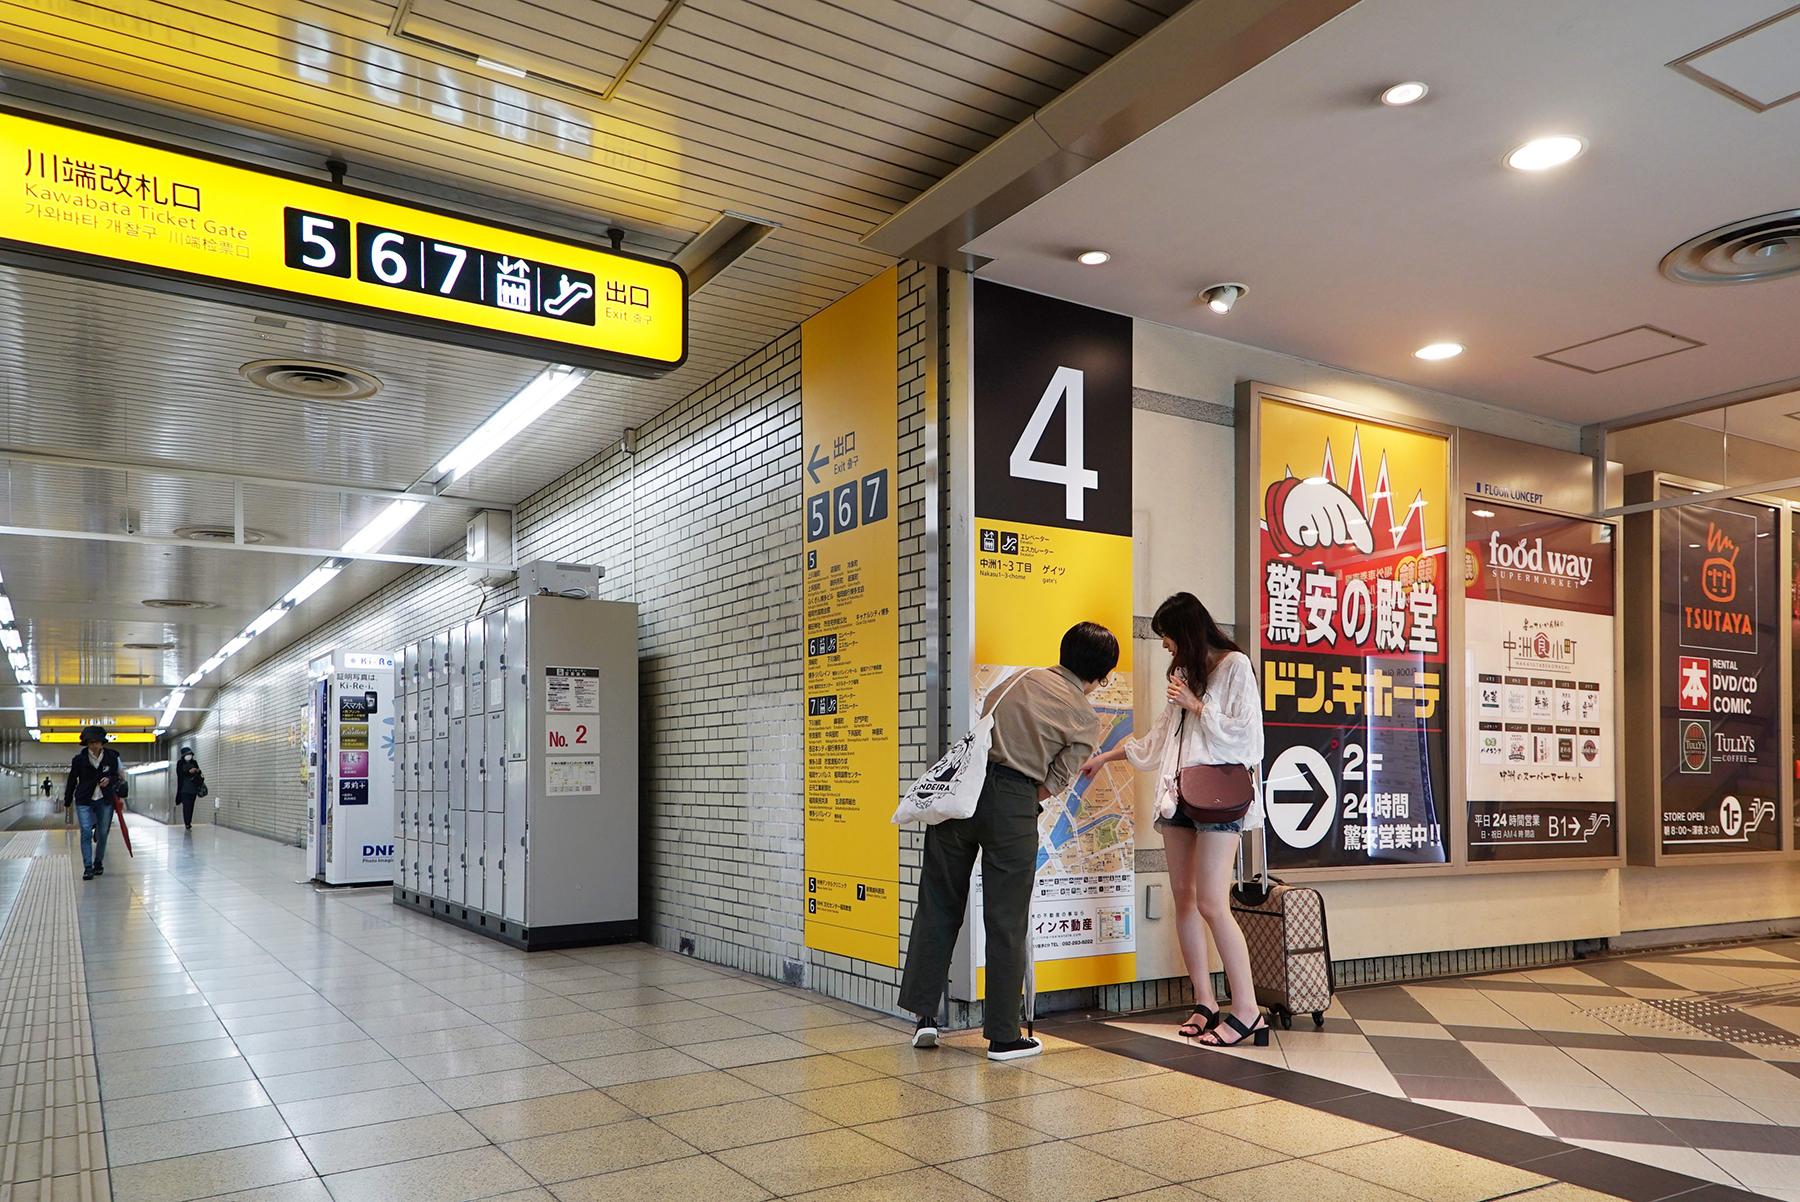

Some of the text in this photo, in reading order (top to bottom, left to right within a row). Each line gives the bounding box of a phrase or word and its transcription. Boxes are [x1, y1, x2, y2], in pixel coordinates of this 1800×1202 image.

[25, 149, 200, 212] 川端改札口
[25, 183, 248, 240] Kawabata Ticket Gate
[25, 203, 157, 239] 가와바타 개찰구
[301, 216, 467, 294] 5 6 7
[606, 280, 649, 309] 出口
[606, 307, 628, 321] Exit
[833, 431, 855, 459] 出口
[1009, 365, 1098, 521] 4
[834, 461, 846, 475] Exit
[1484, 483, 1543, 505] FLOOR CONCEPT
[812, 477, 880, 536] 5 6 7
[1020, 533, 1050, 542] エレベーター
[809, 552, 816, 568] 5
[1020, 545, 1054, 555] エスカレーター
[1489, 530, 1543, 572] food
[1547, 551, 1593, 586] way
[1042, 565, 1066, 576] ゲイツ
[1492, 569, 1579, 589] SUPERMARKET
[1265, 560, 1439, 653] 驚安の殿堂
[1685, 607, 1753, 636] TSUTAYA
[810, 640, 816, 655] 6
[1712, 659, 1739, 671] RENTAL
[336, 672, 376, 681] 証明写真は
[1681, 661, 1708, 706] 本
[1713, 674, 1758, 693] DVD/CD
[810, 699, 816, 714] 7
[1713, 697, 1752, 715] COMIC
[549, 724, 587, 747] No. 2
[1714, 732, 1756, 753] TULLY'S
[1343, 743, 1383, 781] 2F
[1722, 754, 1748, 763] COFFEE
[1343, 792, 1409, 820] 24時間
[1548, 815, 1567, 838] B1
[1664, 812, 1706, 822] STORE OPEN
[1723, 802, 1740, 831] 1F
[809, 878, 815, 892] 5
[858, 885, 864, 899] 7
[809, 899, 815, 912] 6
[1035, 918, 1093, 934] イン不動産
